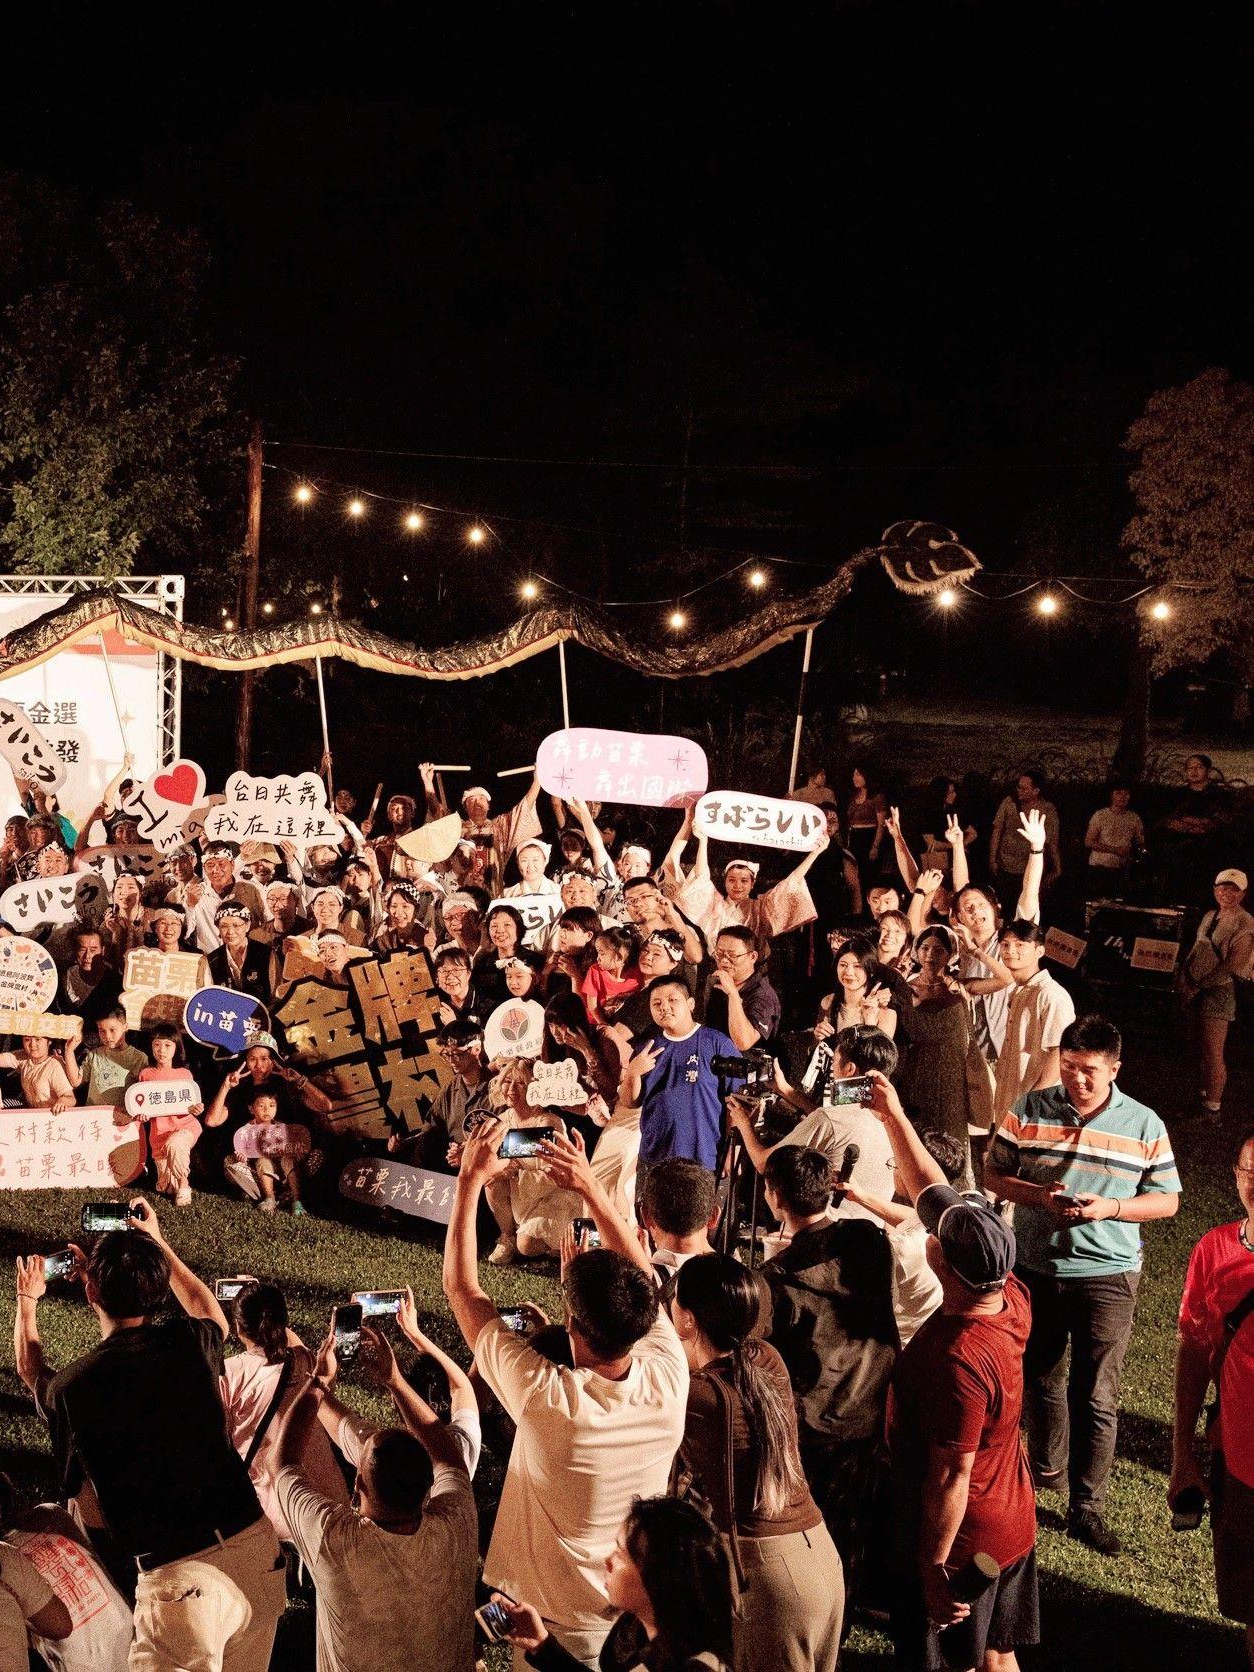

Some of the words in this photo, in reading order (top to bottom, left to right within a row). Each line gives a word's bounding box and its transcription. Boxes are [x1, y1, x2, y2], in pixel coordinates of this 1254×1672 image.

[234, 779, 318, 811] 台日共舞
[213, 811, 336, 837] 我在這裡
[704, 801, 821, 837] すばらしい
[131, 953, 200, 991] 苗栗
[275, 952, 442, 1060] 金牌
[529, 1084, 585, 1102] 我在這裡
